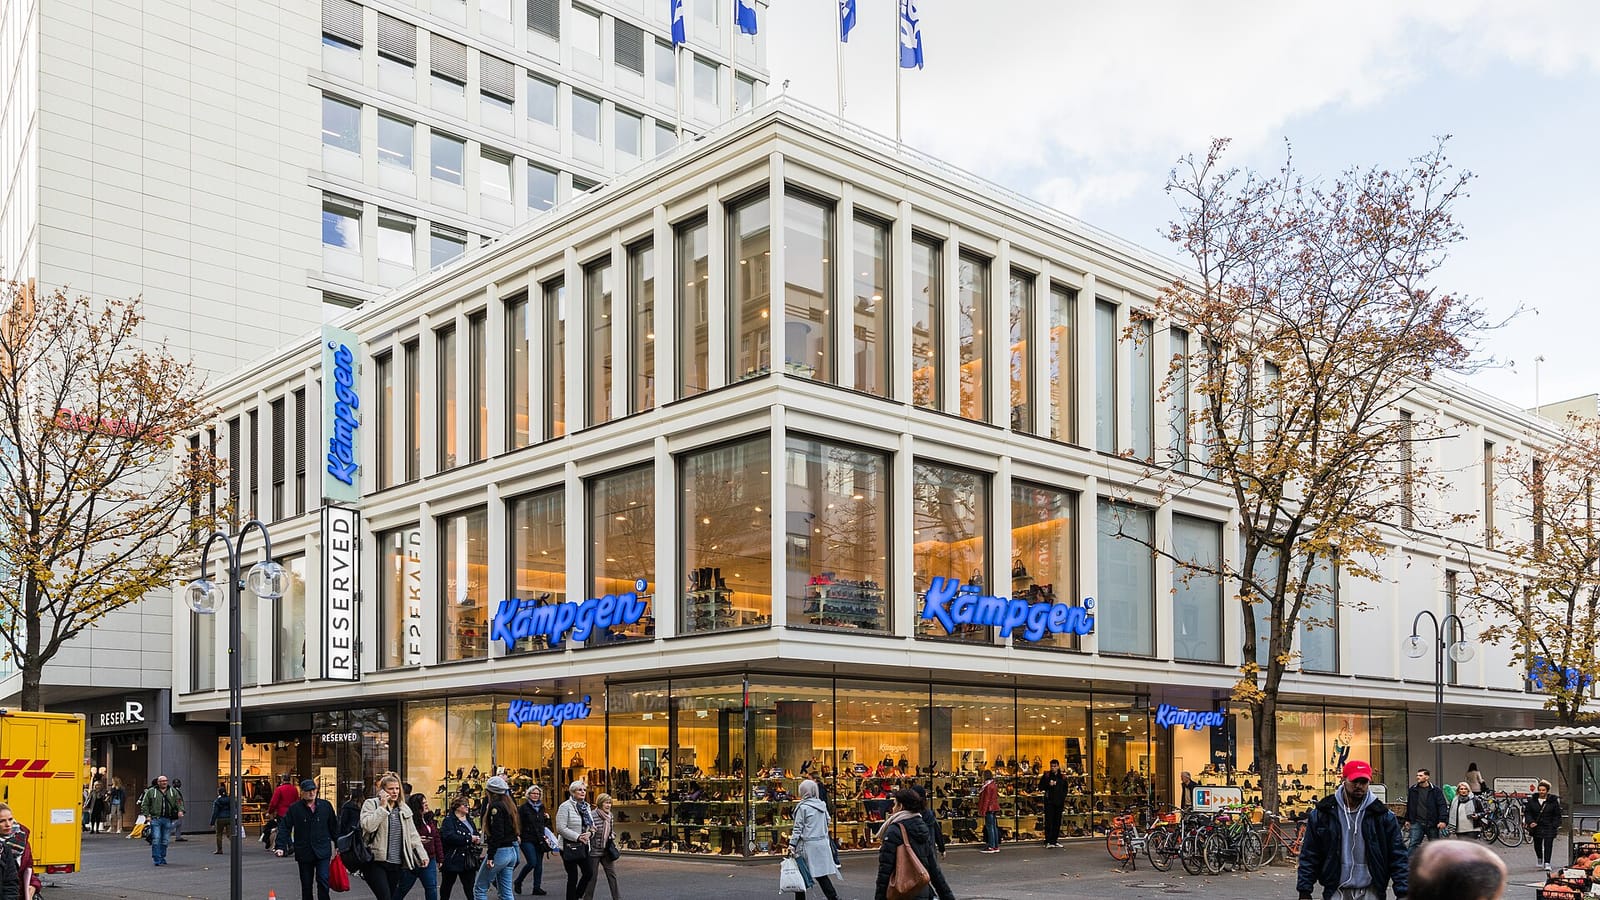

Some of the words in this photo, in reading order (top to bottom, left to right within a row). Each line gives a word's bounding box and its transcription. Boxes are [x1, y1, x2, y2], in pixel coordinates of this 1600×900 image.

[327, 343, 360, 486] Kämpgen
[332, 517, 350, 670] RESERVED
[922, 575, 1095, 643] Kämpgen
[491, 591, 648, 651] Kämpgen
[126, 701, 145, 721] R
[507, 698, 592, 729] Kämpgen
[1155, 703, 1226, 732] Kämpgen
[321, 732, 358, 742] RESERVED
[0, 758, 55, 779] HL
